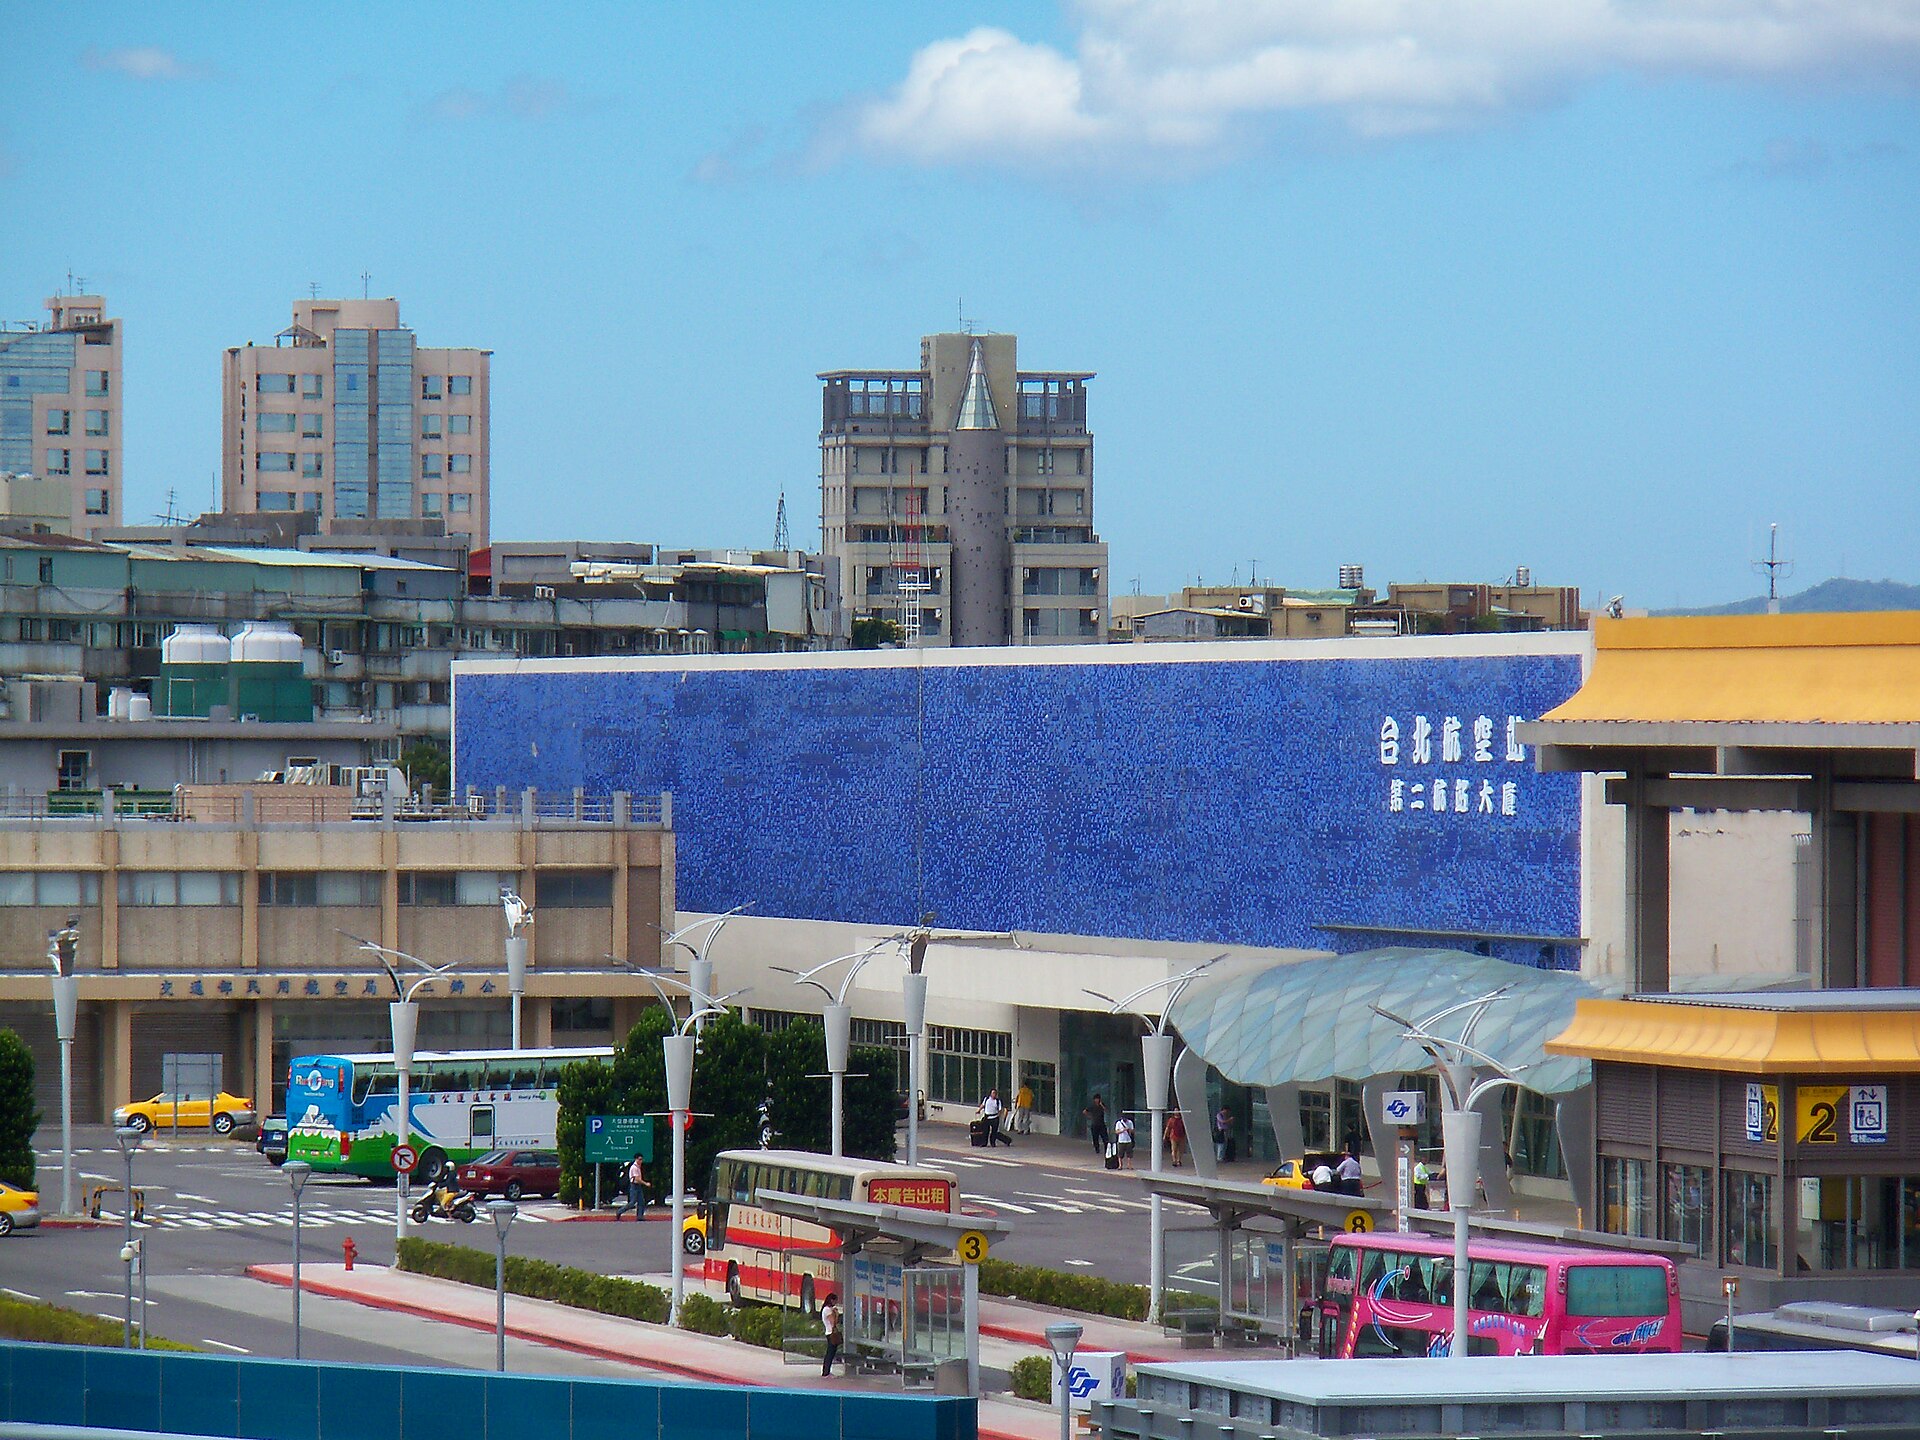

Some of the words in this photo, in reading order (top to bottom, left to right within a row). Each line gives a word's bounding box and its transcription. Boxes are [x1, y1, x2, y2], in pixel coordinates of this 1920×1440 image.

[591, 1119, 603, 1133] P
[1766, 1101, 1777, 1142] 2
[1808, 1101, 1837, 1143] 2
[605, 1135, 634, 1145] 入口
[872, 1187, 945, 1204] 本廣告出租
[1352, 1215, 1366, 1233] 8
[965, 1236, 981, 1260] 3
